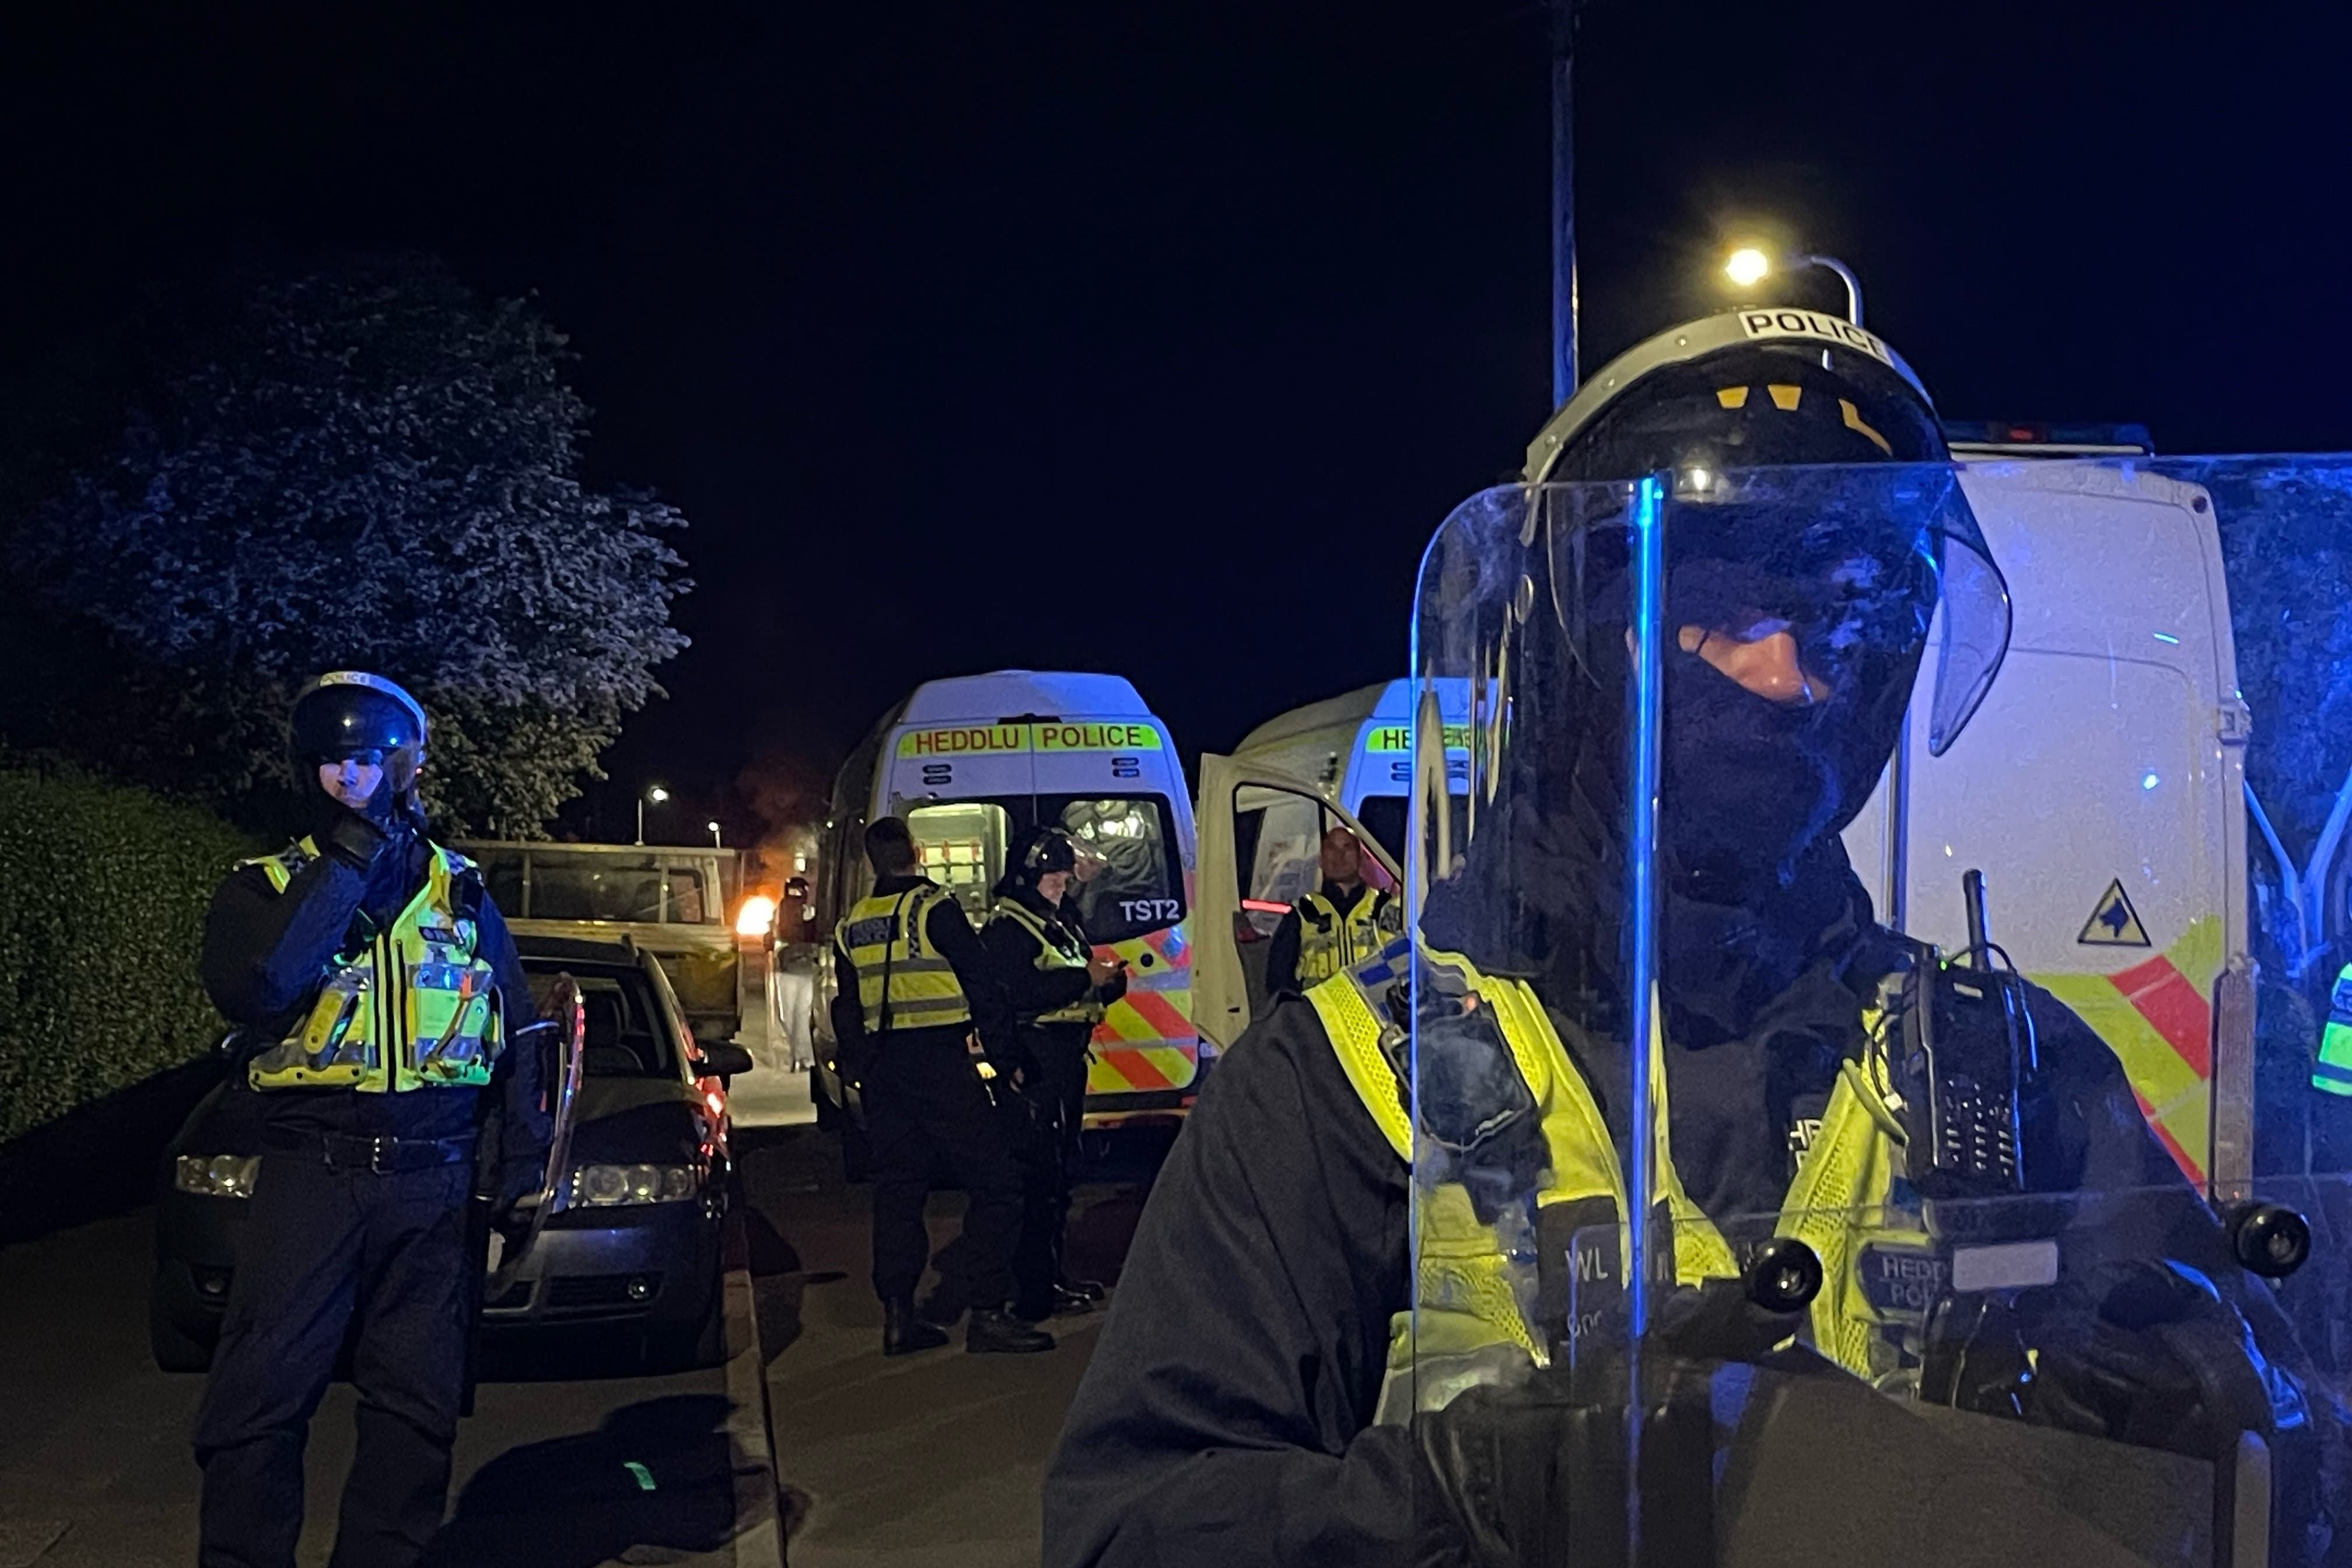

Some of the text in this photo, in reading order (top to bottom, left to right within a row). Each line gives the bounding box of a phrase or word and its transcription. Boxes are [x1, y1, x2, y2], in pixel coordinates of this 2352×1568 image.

[916, 726, 1143, 754] HEDDLU POLICE
[1119, 899, 1180, 922] TST2
